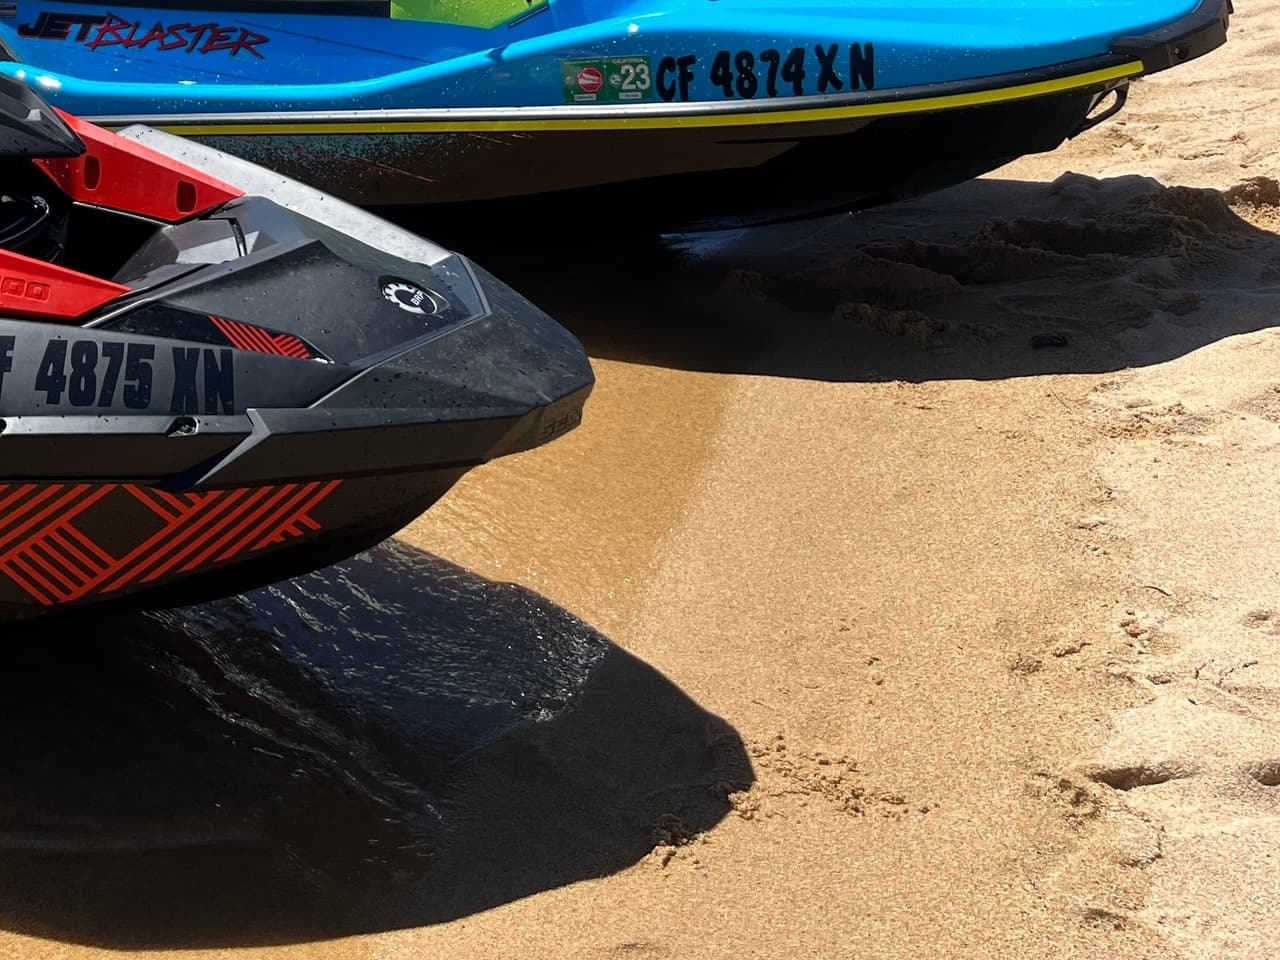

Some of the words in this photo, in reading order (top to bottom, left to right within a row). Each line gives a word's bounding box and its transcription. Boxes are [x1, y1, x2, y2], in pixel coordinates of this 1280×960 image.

[621, 64, 651, 90] 23
[656, 55, 697, 103] CF
[710, 47, 807, 99] 4874
[34, 339, 156, 410] 4875
[169, 347, 235, 416] XN
